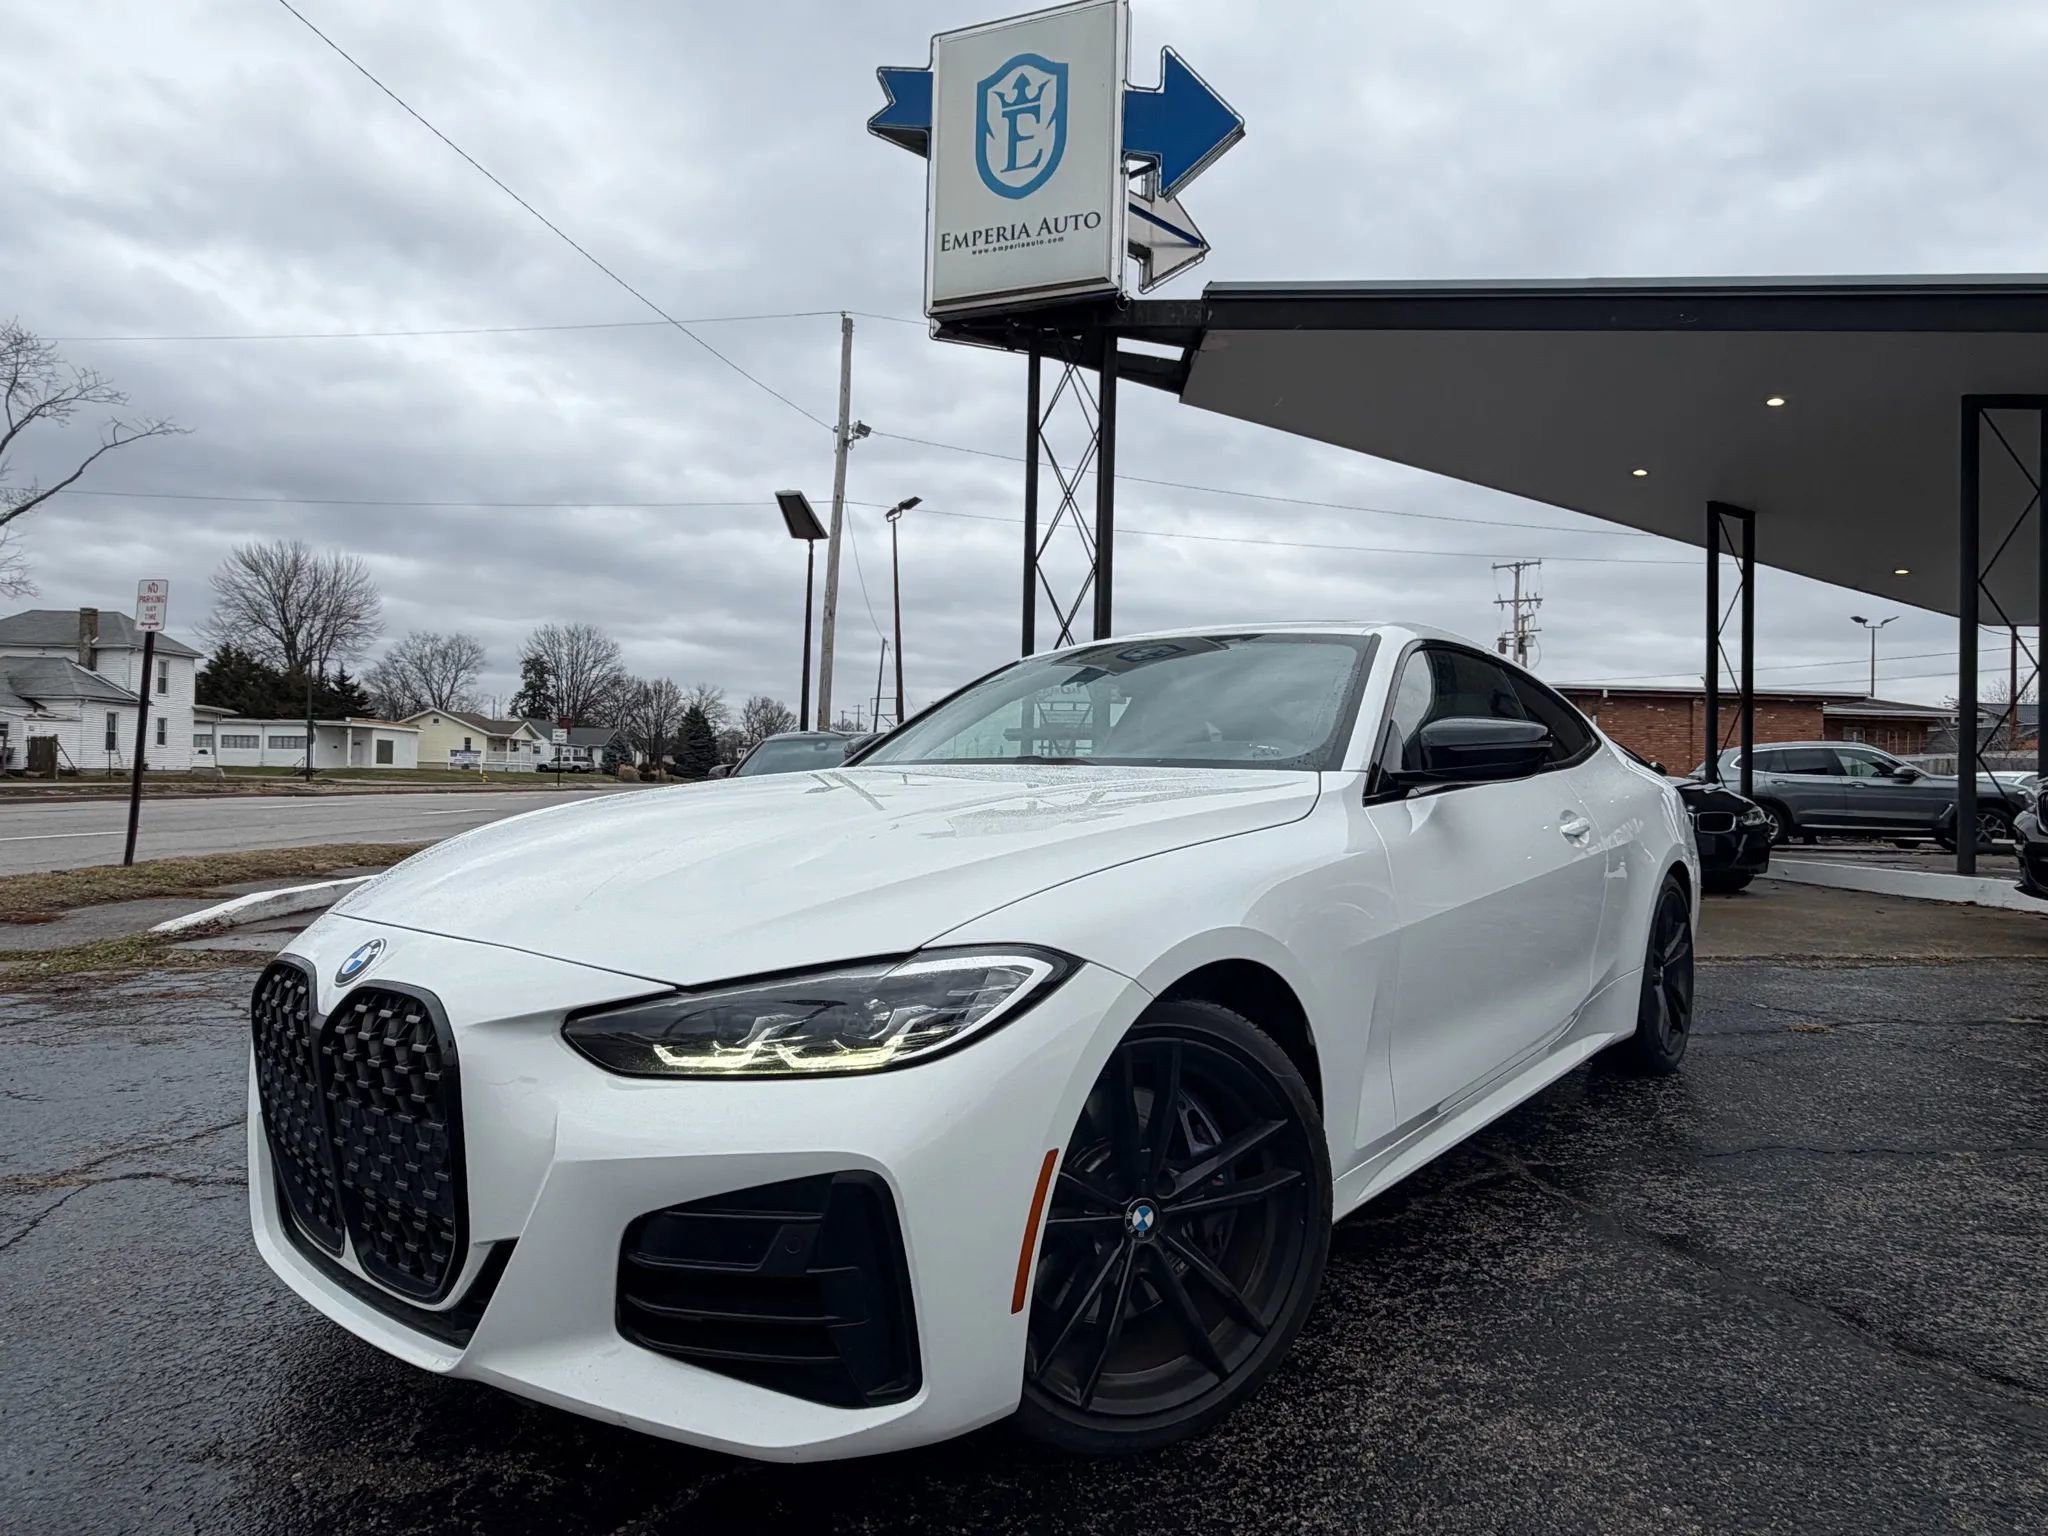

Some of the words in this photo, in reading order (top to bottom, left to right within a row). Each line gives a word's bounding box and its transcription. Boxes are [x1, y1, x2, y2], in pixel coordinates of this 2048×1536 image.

[1000, 103, 1043, 174] E
[941, 222, 1031, 252] EMPERIA
[1036, 211, 1101, 236] AUTO
[971, 236, 1065, 255] www.emperiaauto.com
[147, 583, 158, 593] NO
[139, 595, 166, 603] PARKING
